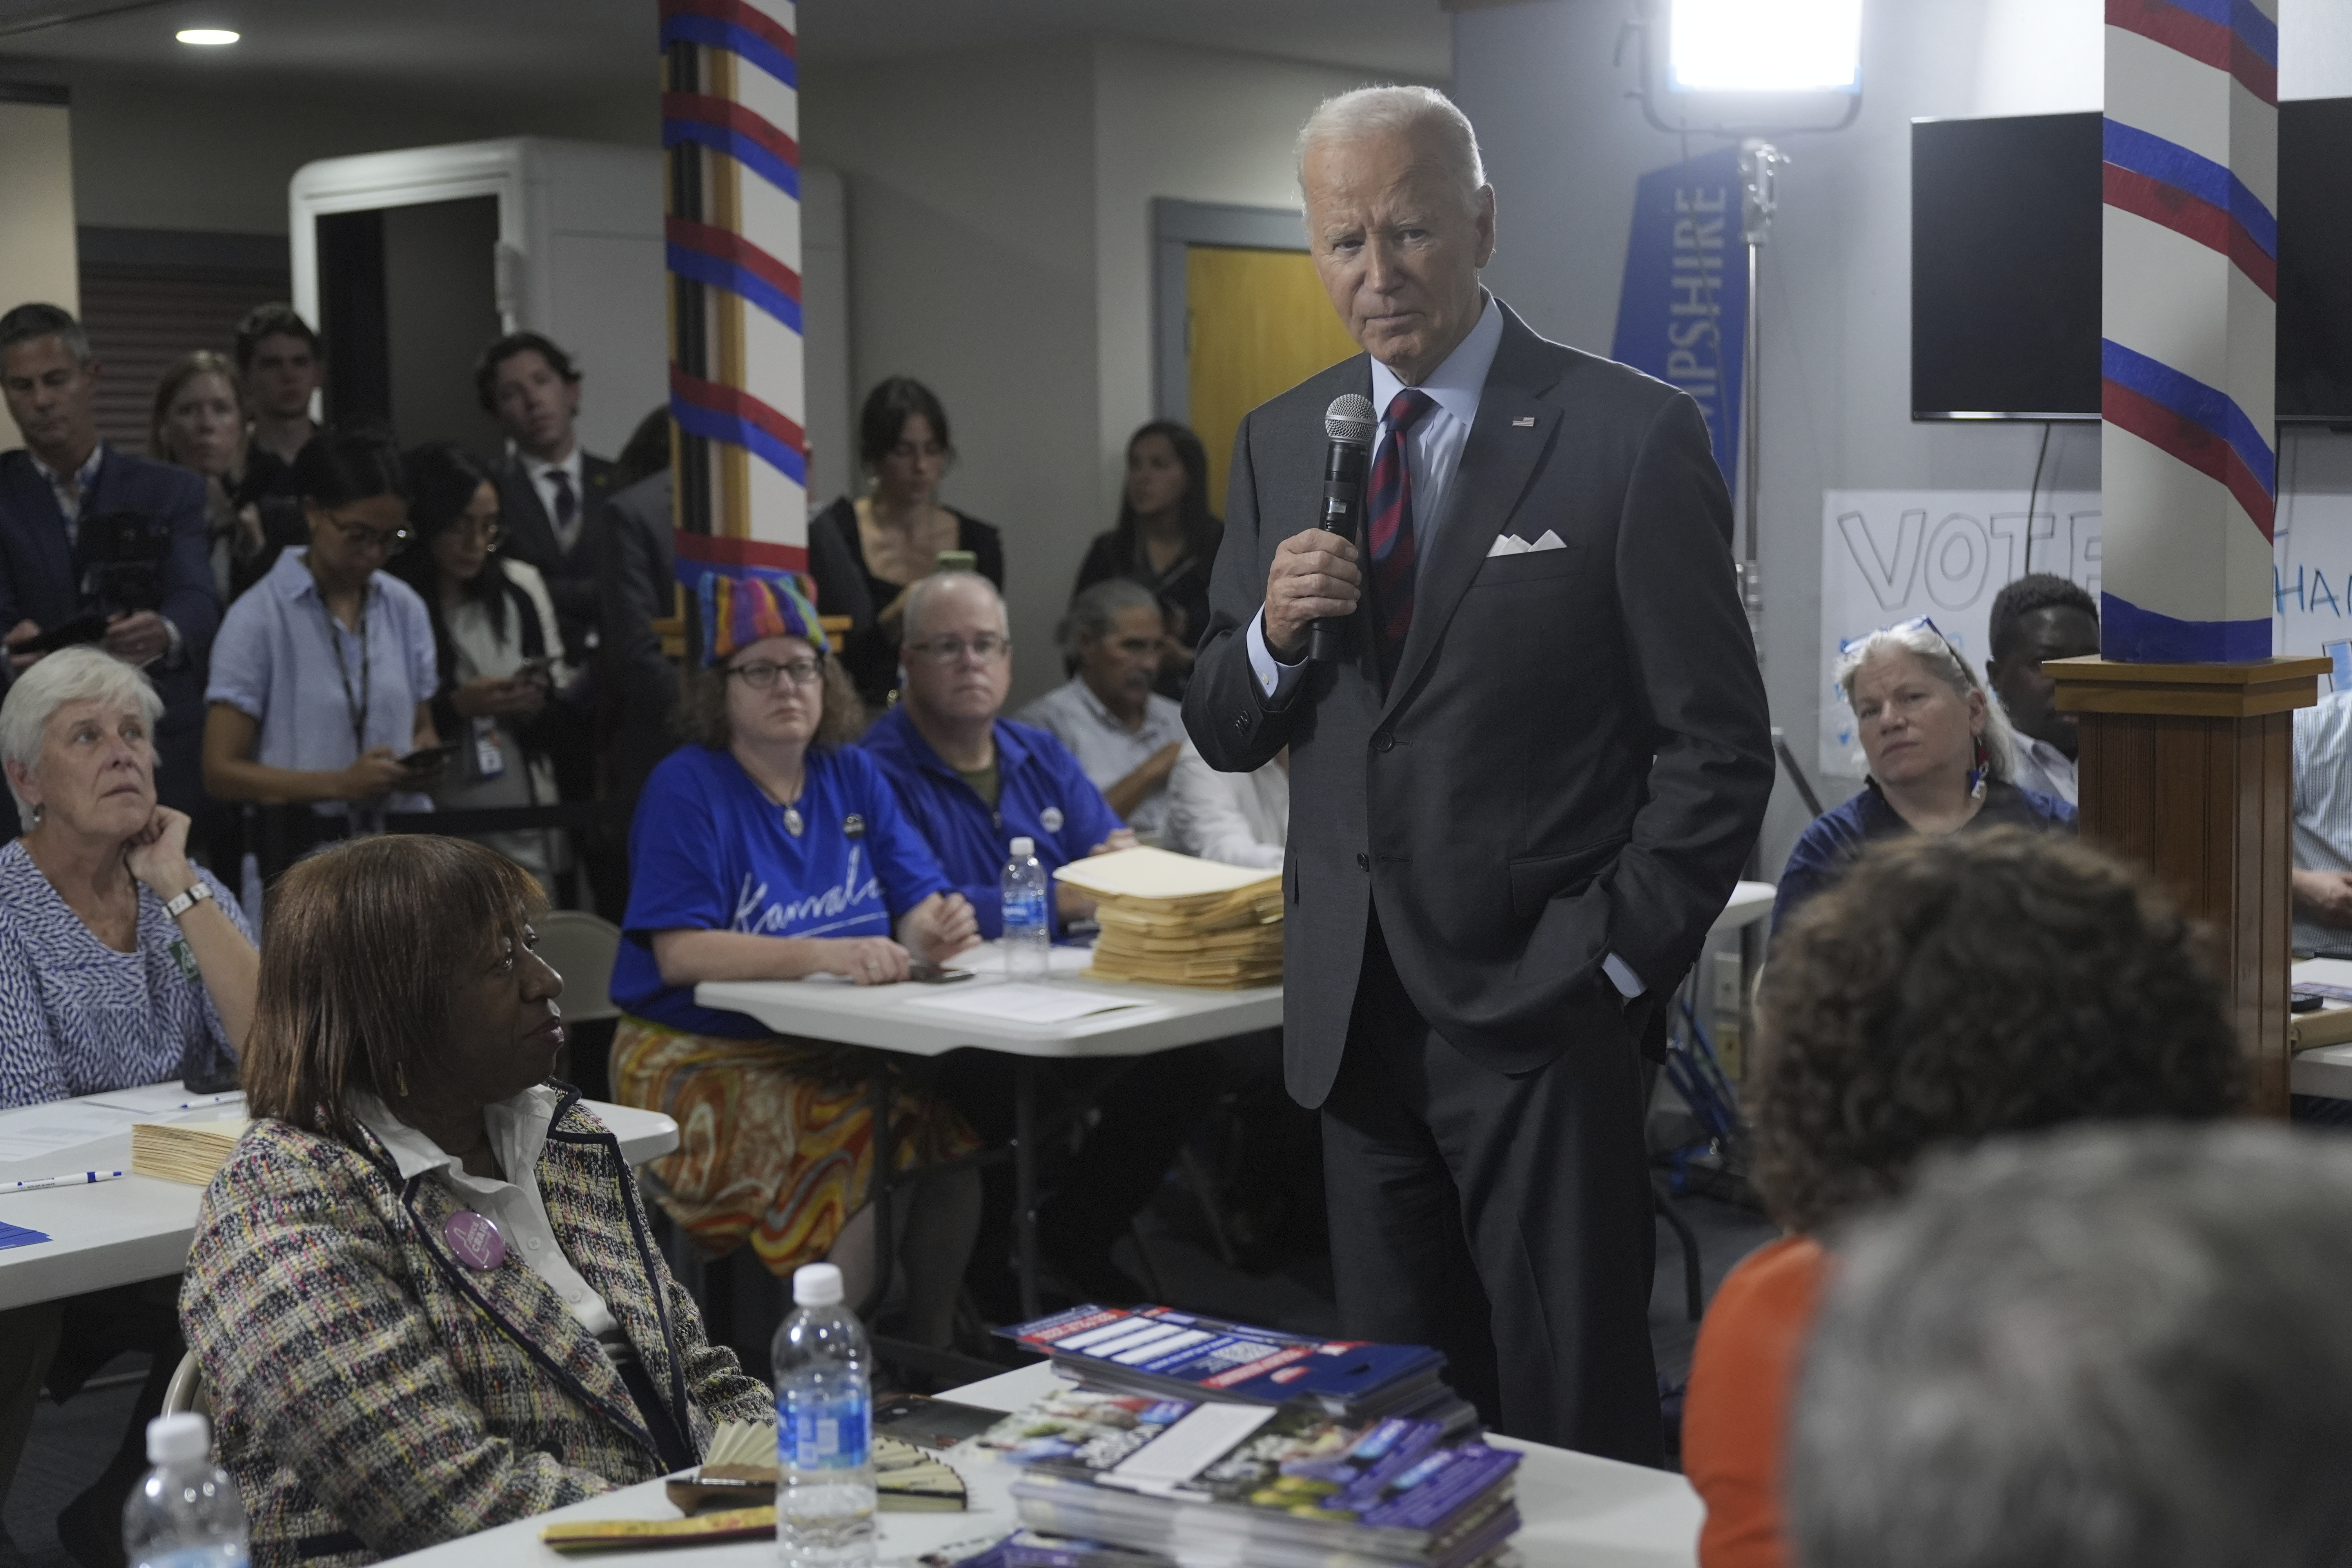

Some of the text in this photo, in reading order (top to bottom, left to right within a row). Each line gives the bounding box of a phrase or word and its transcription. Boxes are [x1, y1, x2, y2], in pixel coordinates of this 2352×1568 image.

[1837, 508, 2102, 612] VOTE
[730, 844, 887, 937] Kamala
[472, 1221, 489, 1252] CRAIG
